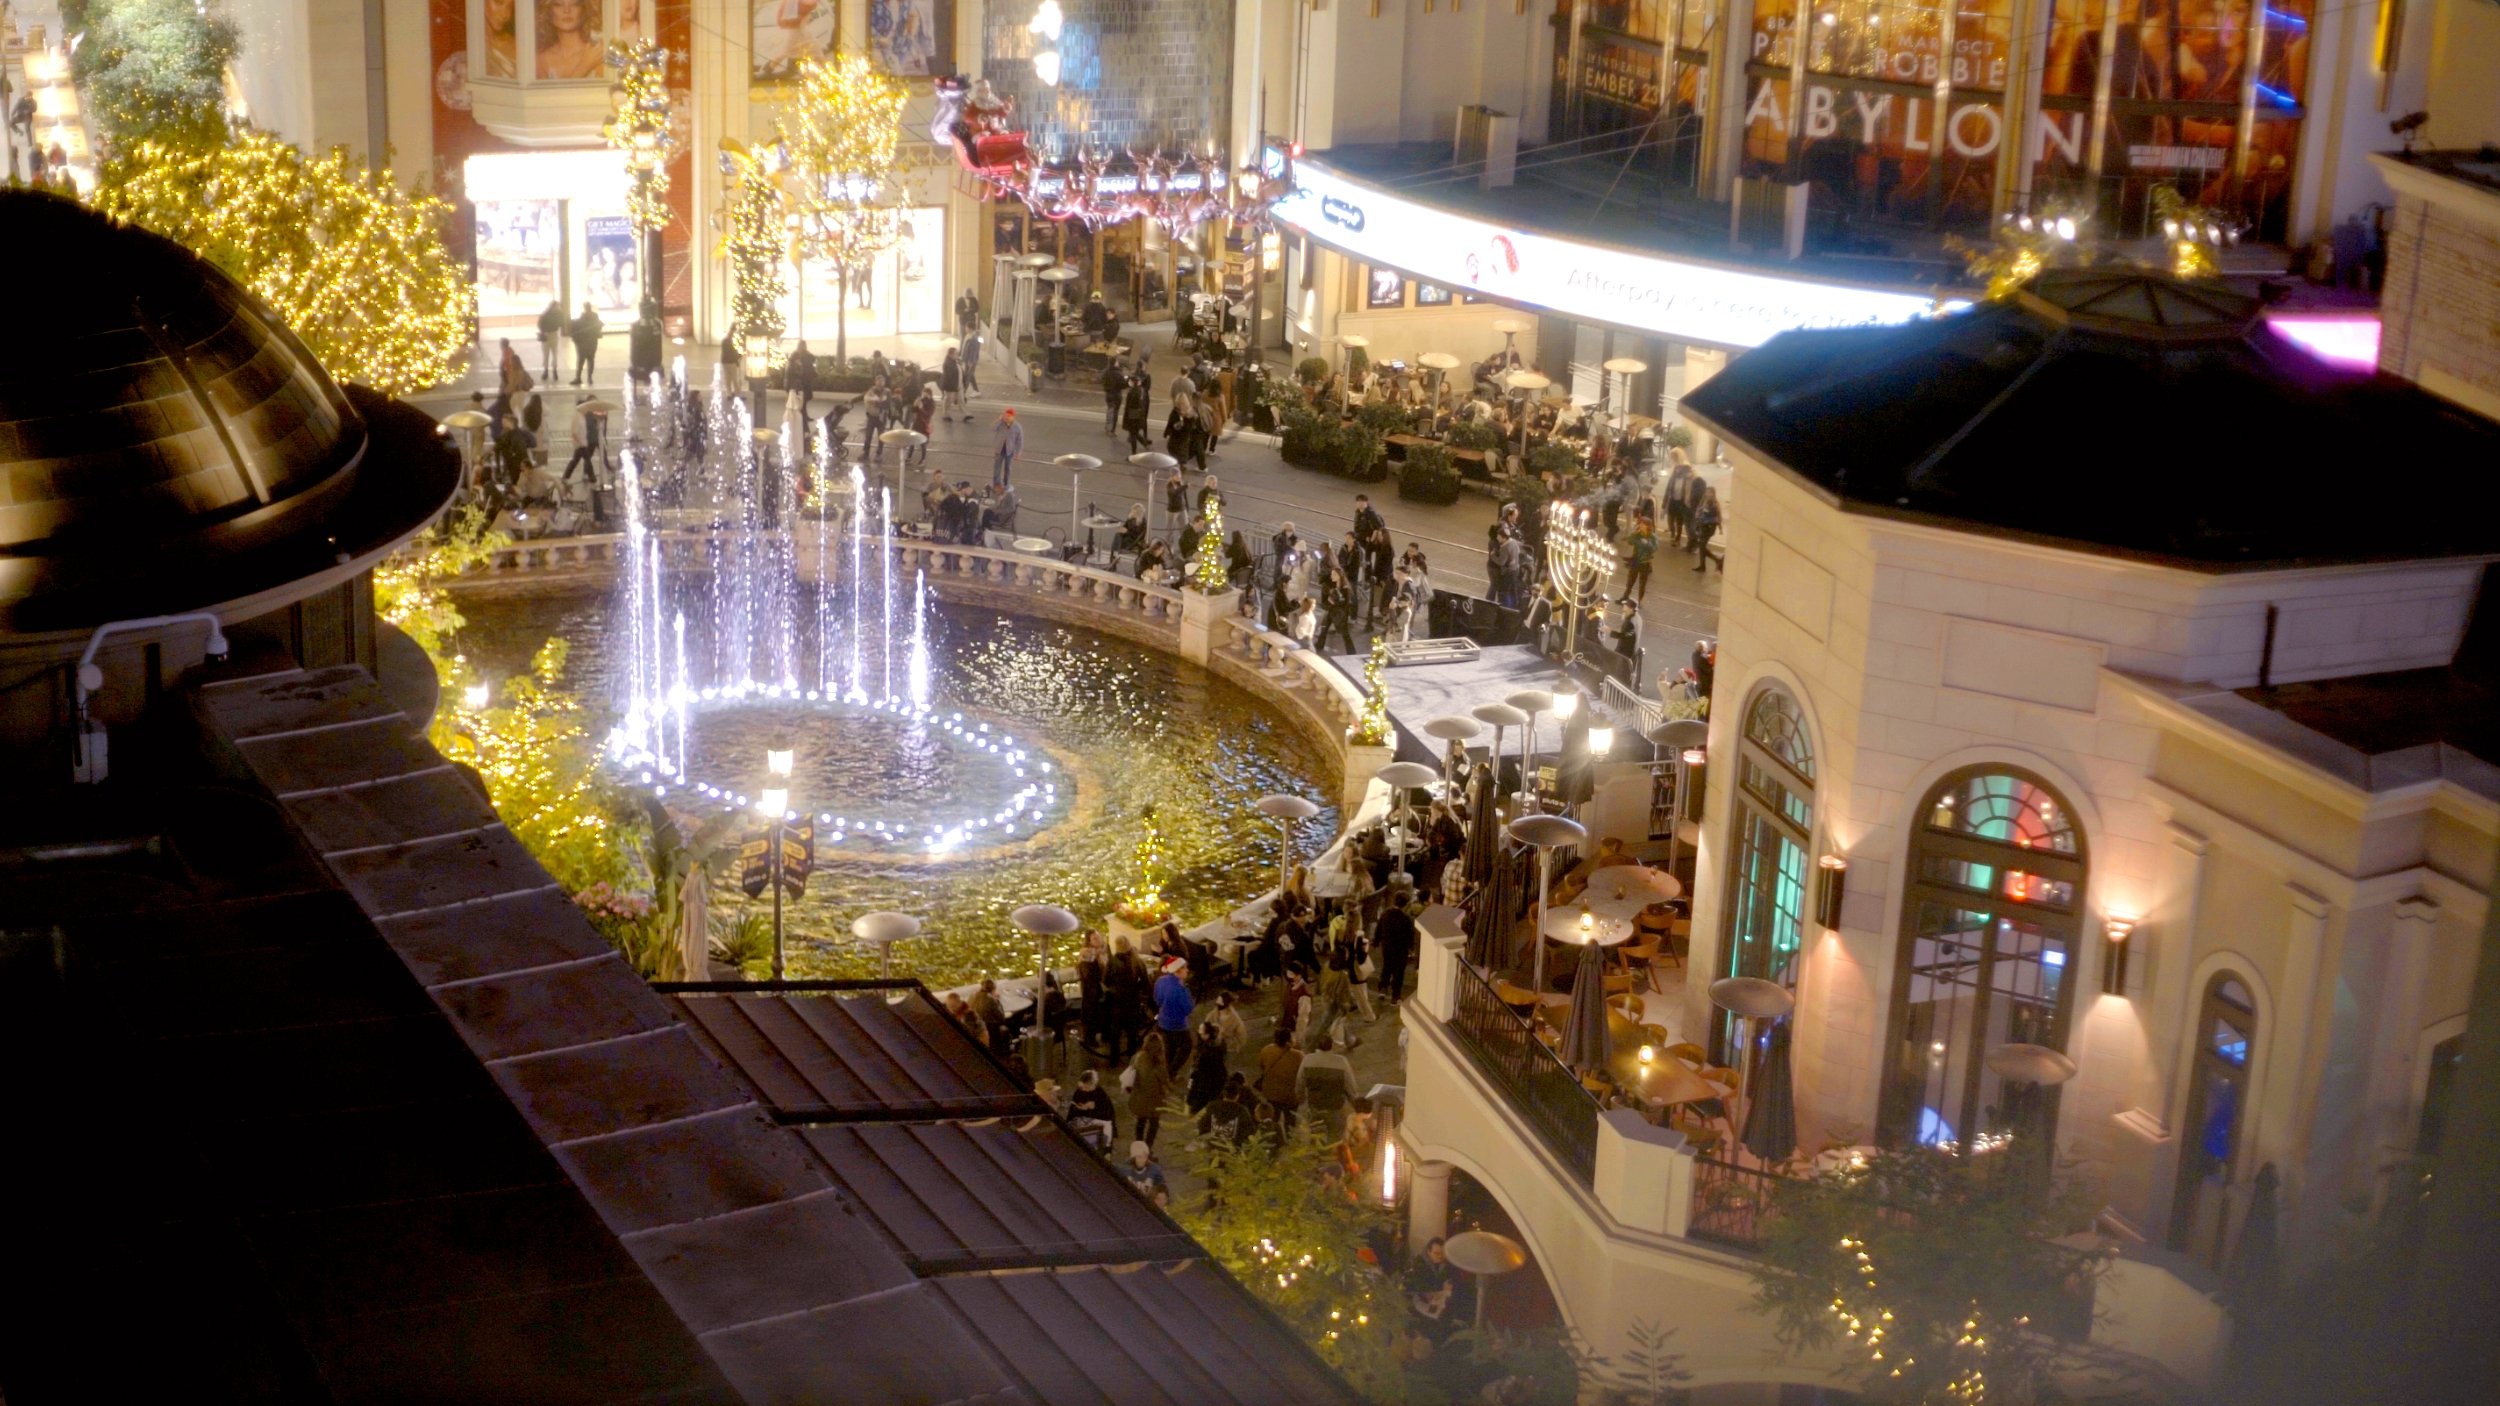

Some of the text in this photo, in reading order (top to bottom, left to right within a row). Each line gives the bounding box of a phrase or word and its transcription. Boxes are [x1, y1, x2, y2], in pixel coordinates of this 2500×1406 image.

[1753, 31, 1827, 65] PITT
[1898, 35, 1996, 55] MARGOT
[1874, 47, 2007, 87] ROBBIE
[1641, 82, 1659, 105] 23
[1566, 267, 1677, 312] Afterpay
